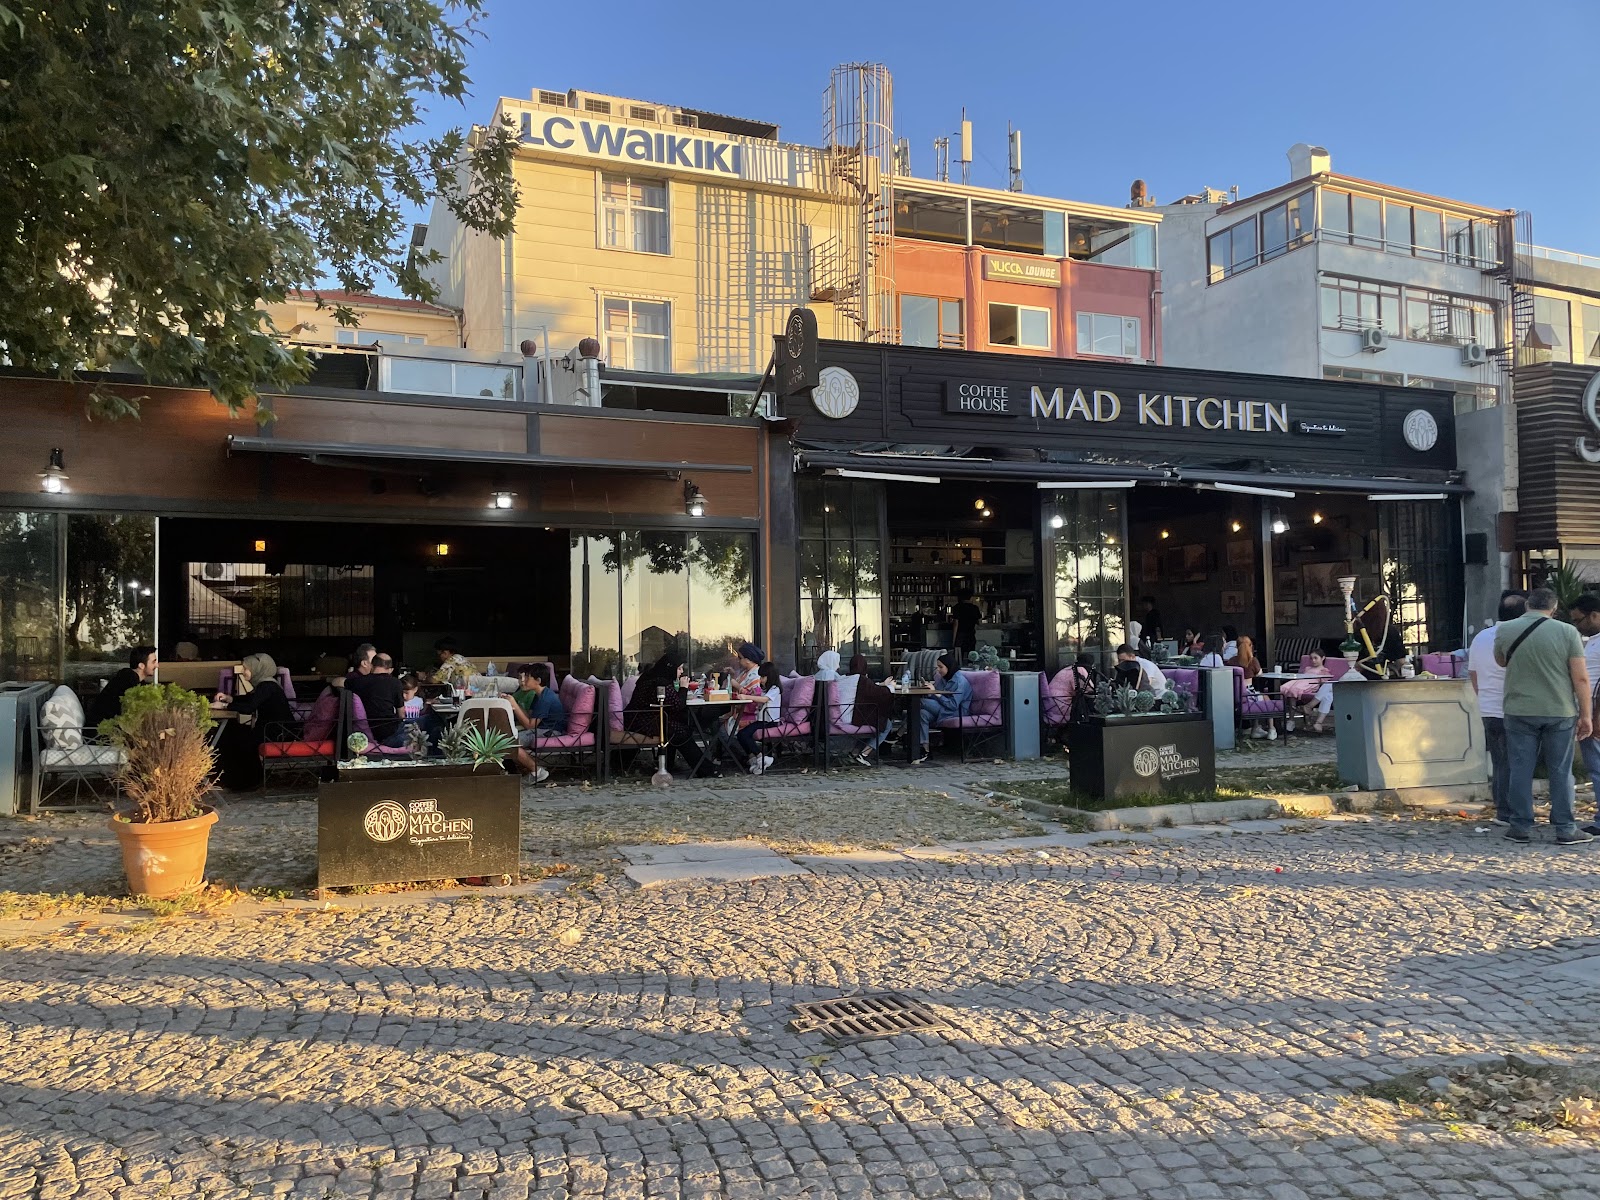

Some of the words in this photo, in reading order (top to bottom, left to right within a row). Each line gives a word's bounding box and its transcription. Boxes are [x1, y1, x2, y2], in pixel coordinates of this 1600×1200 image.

[520, 112, 575, 149] LC
[990, 260, 1023, 274] YUCCA
[1025, 265, 1056, 278] LOUNGE
[959, 384, 1009, 398] COFFEE
[960, 397, 1009, 412] HOUSE
[1031, 385, 1121, 422] MAD
[1138, 393, 1289, 433] KITCHEN
[1160, 755, 1180, 763] MAD
[1161, 759, 1198, 772] KITCHEN
[409, 806, 435, 814] HOUSE
[410, 813, 442, 825] MAD
[410, 820, 470, 835] KITCHEN
